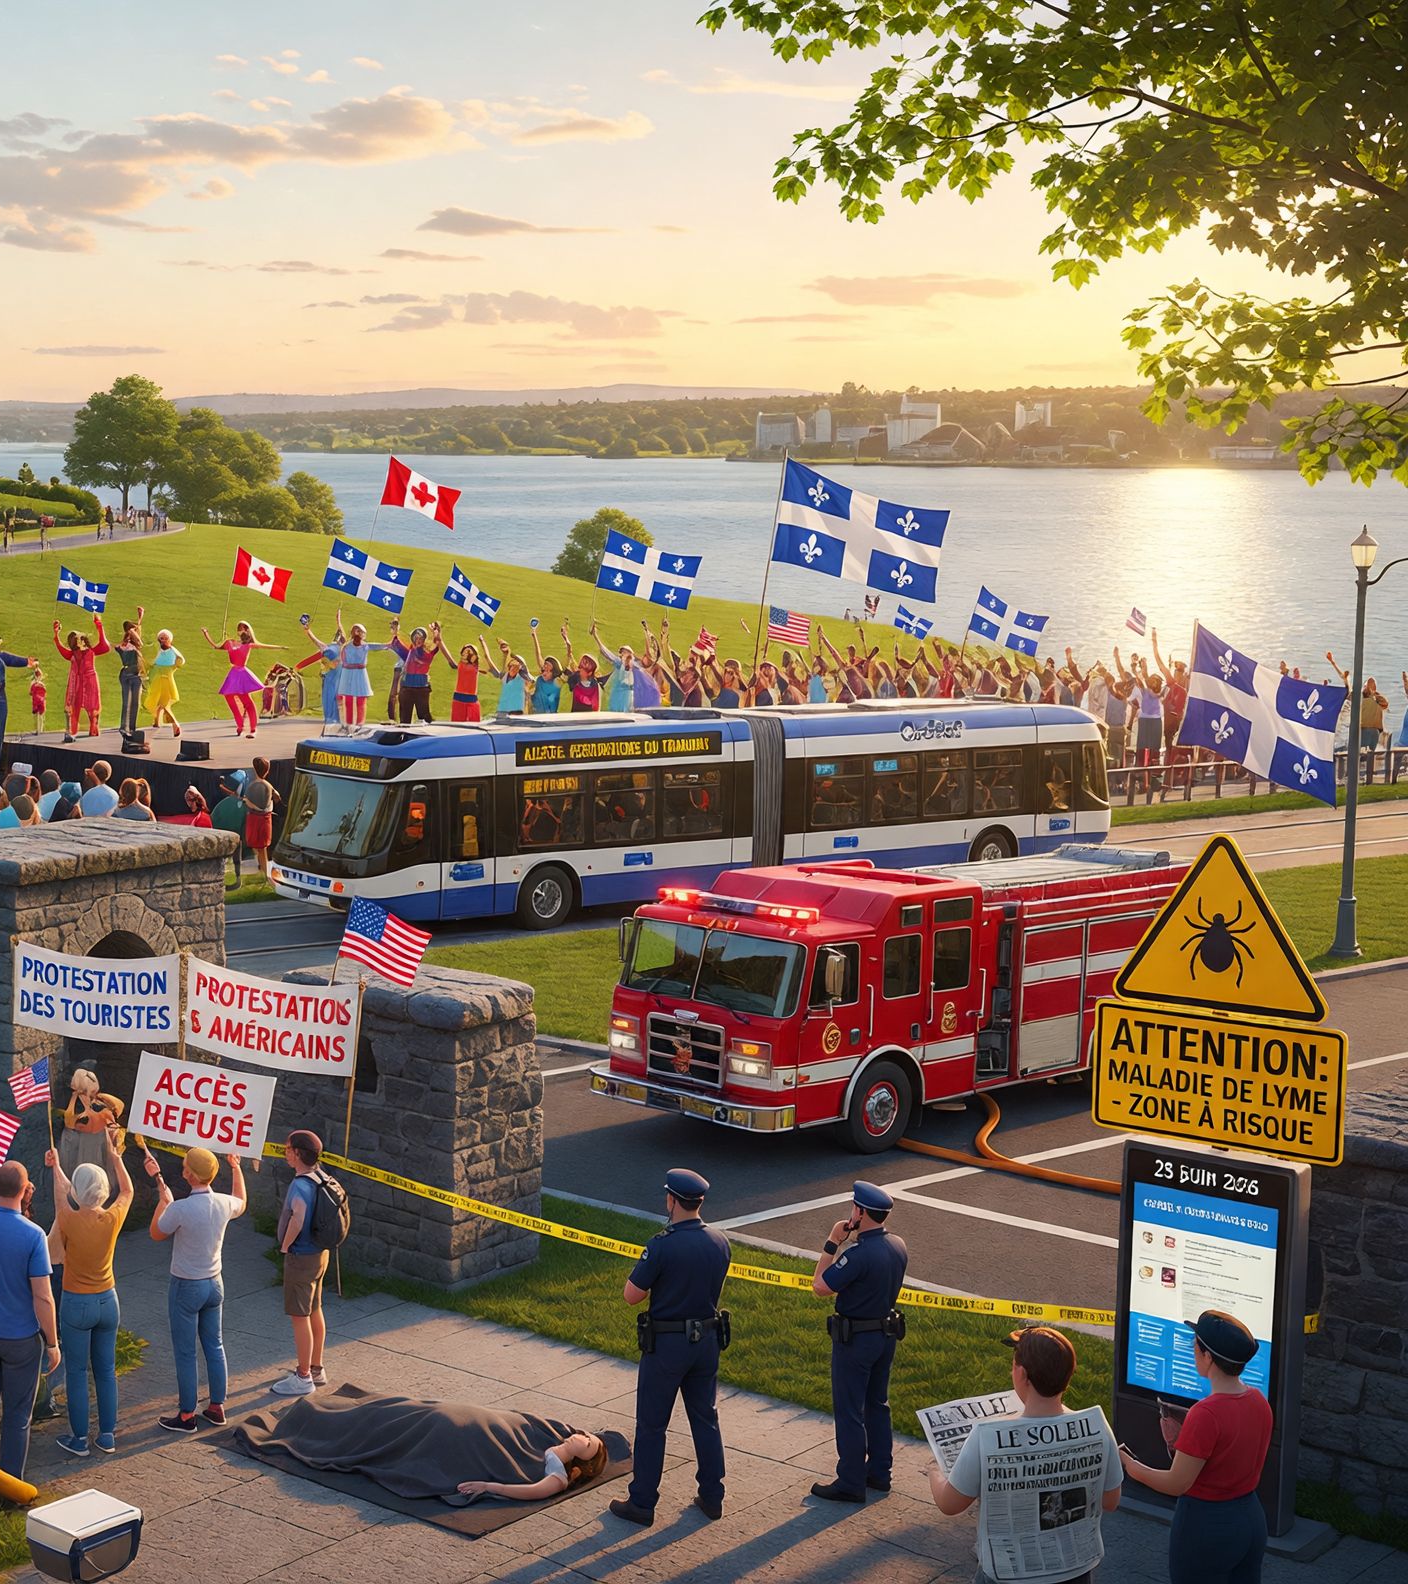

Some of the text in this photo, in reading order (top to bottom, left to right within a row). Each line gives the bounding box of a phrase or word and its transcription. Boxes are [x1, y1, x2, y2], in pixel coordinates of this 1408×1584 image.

[21, 955, 168, 996] PROTESTATION
[20, 989, 171, 1031] DES TOURISTES
[208, 1016, 346, 1063] AMÉRICAINS
[1110, 1017, 1328, 1083] ATTENTION:
[154, 1068, 248, 1111] ACCÈS
[1108, 1058, 1328, 1116] MALADIE DE LYME
[143, 1099, 254, 1148] REFUSÉ
[1128, 1093, 1191, 1125] ZONE
[1198, 1100, 1215, 1130] À
[1223, 1108, 1314, 1146] RISQUE
[995, 1430, 1022, 1449] LE
[1027, 1417, 1101, 1446] SOLEIL
